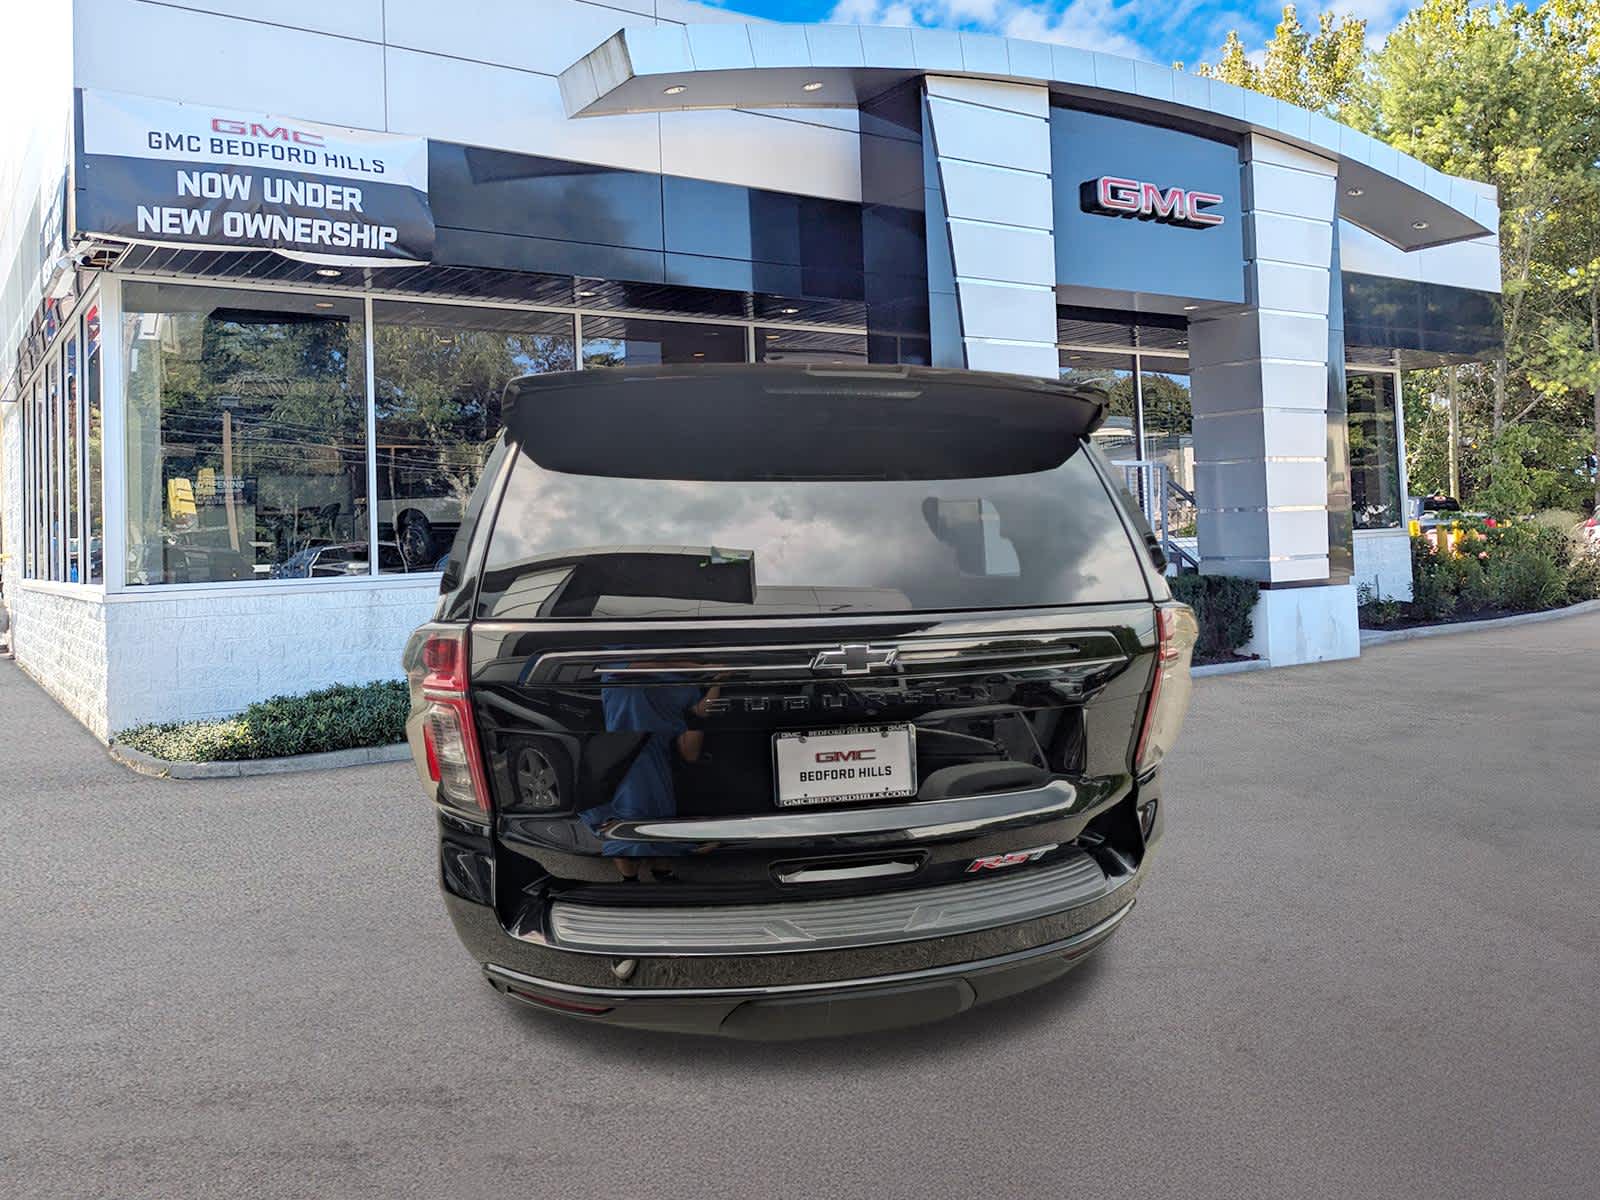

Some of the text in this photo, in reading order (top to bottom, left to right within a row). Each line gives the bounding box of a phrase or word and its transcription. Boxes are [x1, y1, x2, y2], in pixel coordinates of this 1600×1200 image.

[211, 117, 325, 148] GMC
[148, 131, 385, 174] GMC BEDFORD HILLS
[176, 169, 363, 213] NOW UNDER
[1098, 175, 1225, 225] GMC
[136, 205, 398, 250] NEW OWNERSHIP
[799, 766, 892, 782] BEDFORD HILLS
[815, 749, 876, 763] GMC
[964, 843, 1059, 872] RST
